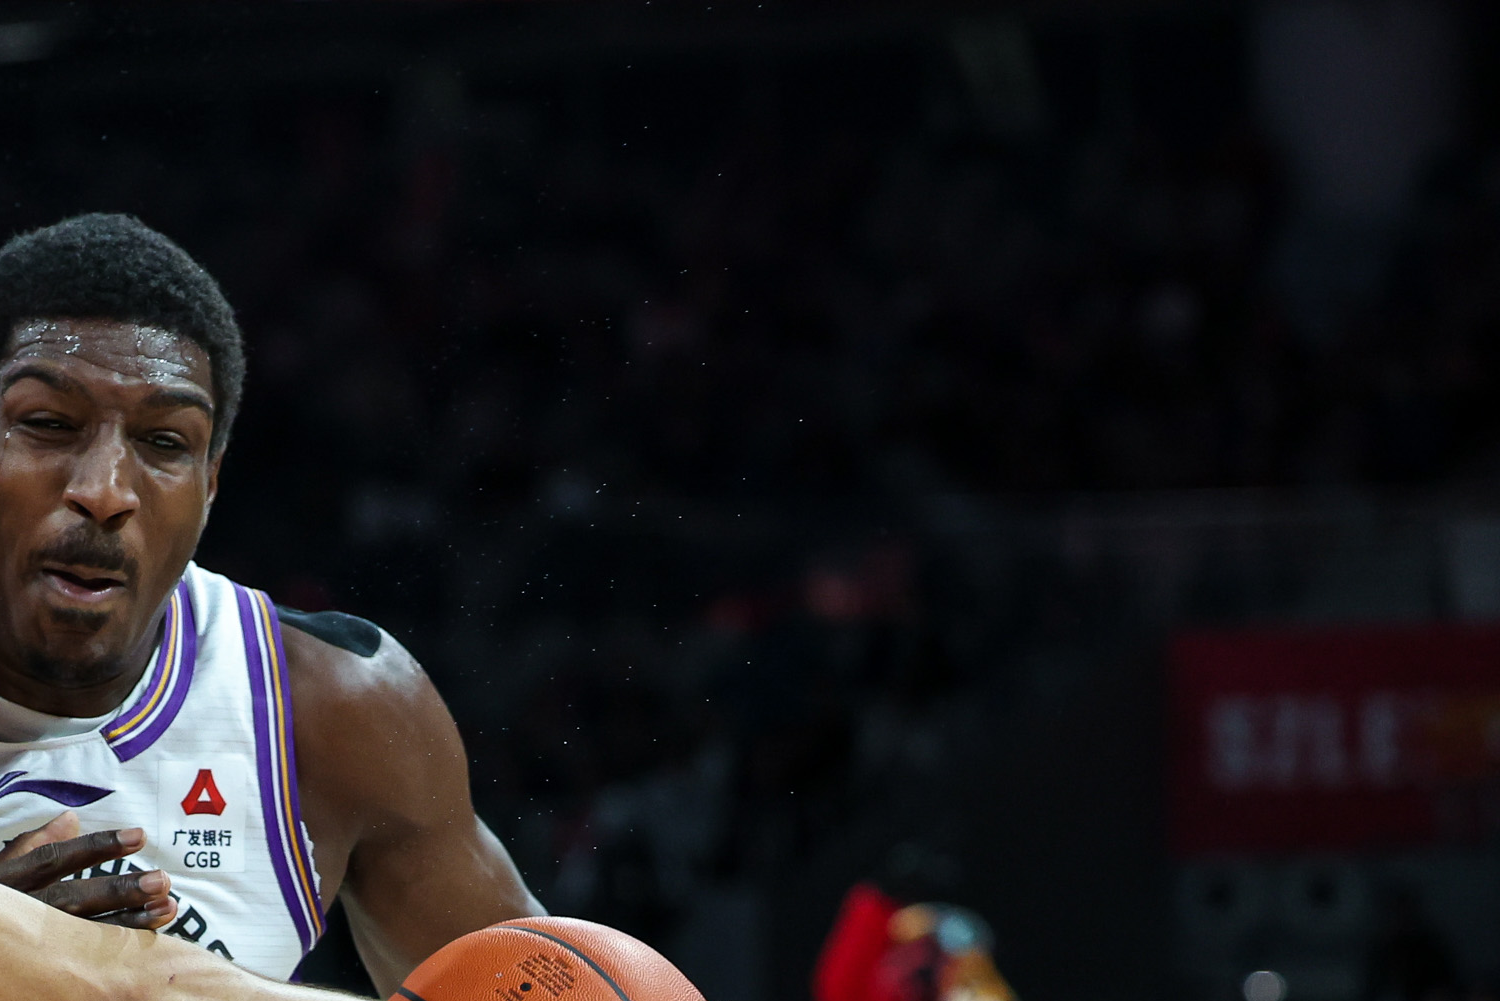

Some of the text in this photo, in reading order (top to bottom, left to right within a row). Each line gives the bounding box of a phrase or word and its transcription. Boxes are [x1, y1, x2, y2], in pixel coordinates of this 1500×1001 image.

[172, 829, 232, 846] 广发银行
[183, 851, 221, 868] CGB
